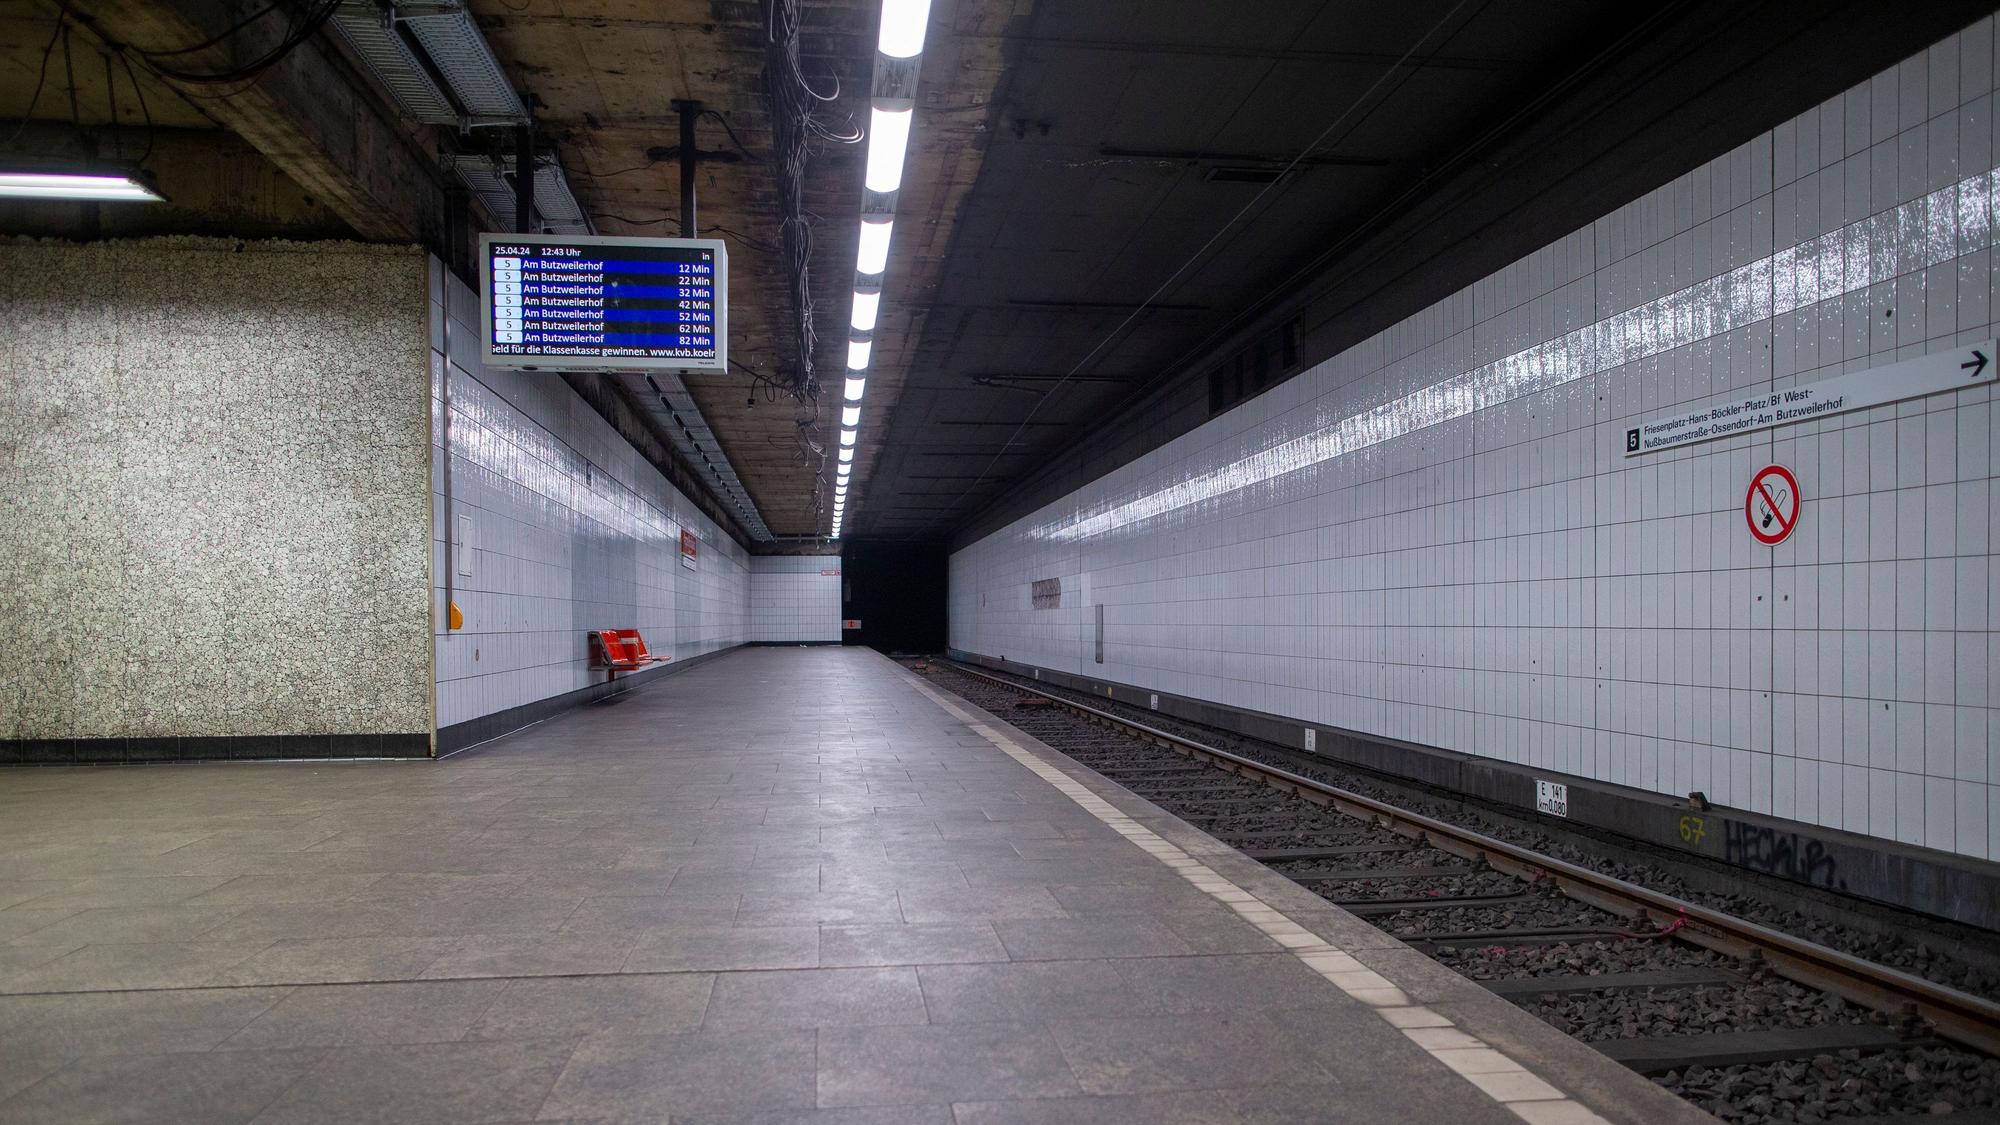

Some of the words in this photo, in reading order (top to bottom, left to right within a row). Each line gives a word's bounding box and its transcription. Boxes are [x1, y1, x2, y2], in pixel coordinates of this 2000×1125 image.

[495, 246, 530, 255] 25.04.24
[541, 247, 564, 256] 12:43
[566, 248, 582, 257] Uhr
[702, 252, 710, 260] in
[505, 260, 510, 268] 5
[541, 261, 604, 270] Butzweilerhof
[679, 265, 690, 274] 12
[692, 265, 710, 274] Min
[505, 272, 511, 280] 5
[523, 273, 538, 281] Am
[541, 273, 604, 283] Butzweilerhof
[679, 277, 690, 286] 22
[692, 277, 710, 286] Min
[506, 284, 511, 292] 5
[524, 285, 539, 293] Am
[542, 285, 604, 295] Butzweilerhof
[679, 289, 690, 298] 32
[692, 289, 710, 298] Min
[506, 296, 511, 304] 5
[524, 297, 539, 306] Am
[542, 297, 604, 307] Butzweilerhof
[679, 301, 690, 310] 42
[692, 301, 710, 310] Min
[506, 309, 512, 317] 5
[524, 309, 539, 318] Am
[542, 309, 604, 319] Butzweilerhof
[679, 312, 690, 321] 52
[692, 312, 710, 321] Min
[506, 321, 512, 329] 5
[524, 321, 540, 330] Am
[542, 321, 604, 331] Butzweilerhof
[679, 325, 690, 333] 62
[692, 325, 710, 333] Min
[507, 333, 512, 341] 5
[525, 334, 540, 342] Am
[543, 334, 604, 344] Butzweilerhof
[679, 337, 690, 345] 82
[692, 337, 710, 345] Min
[511, 345, 525, 354] für
[526, 346, 541, 354] die
[543, 346, 600, 355] Klassenkasse
[602, 347, 648, 357] gewinnen.
[1644, 393, 1782, 435] Friesenplatz-Hans-Böckler-Platz/Bf
[1784, 390, 1814, 403] West-
[1644, 413, 1773, 449] Nußbaumerstraße-Ossendorf-Am
[1776, 397, 1843, 421] Butzweilerhof
[1630, 433, 1637, 447] 5
[1541, 782, 1546, 796] E
[1552, 785, 1563, 800] 141
[1679, 815, 1706, 846] 67
